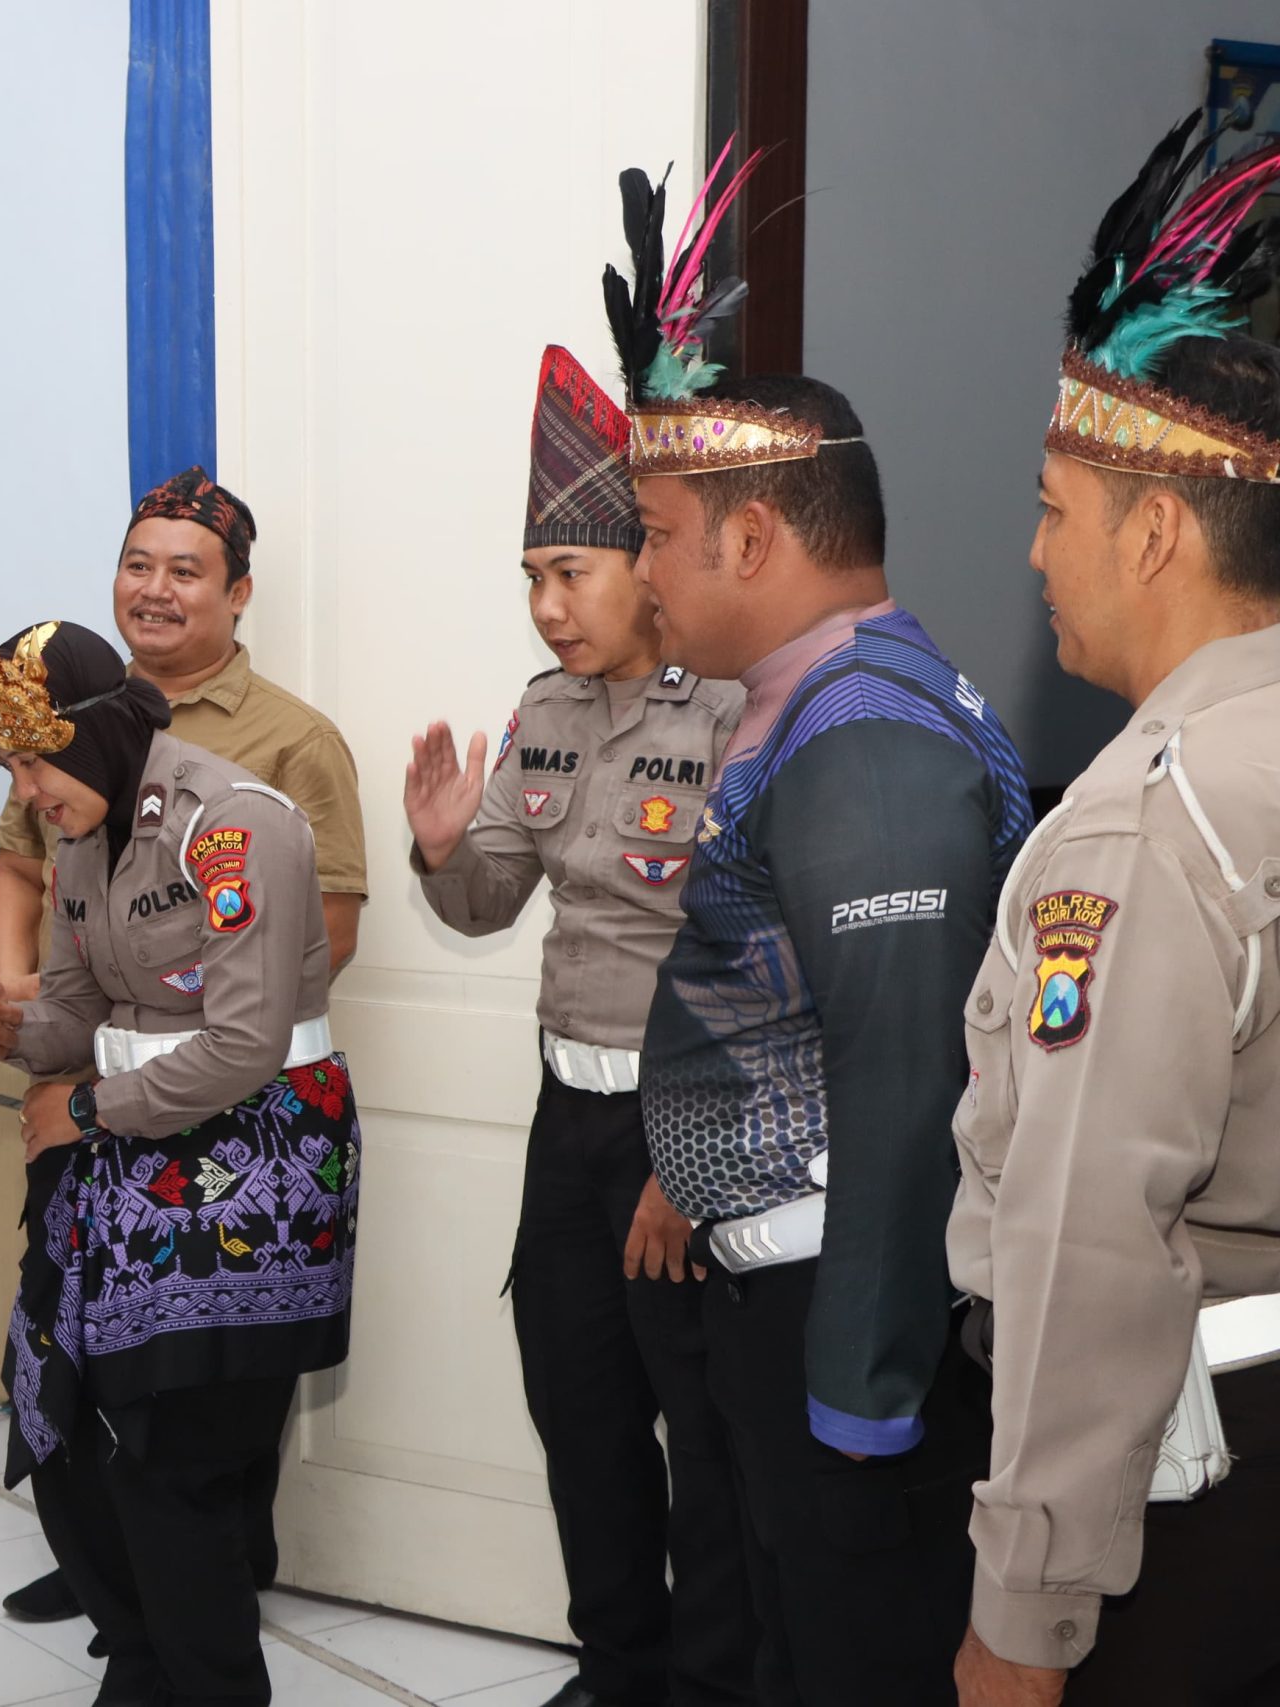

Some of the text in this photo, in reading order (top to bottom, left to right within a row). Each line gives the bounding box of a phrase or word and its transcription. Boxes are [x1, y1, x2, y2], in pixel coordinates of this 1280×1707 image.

[629, 756, 705, 785] POLRI
[191, 831, 243, 860] POLRES
[220, 841, 243, 851] KOTA
[203, 861, 240, 879] JAWA TIMUR
[127, 880, 199, 922] POLRI
[832, 889, 948, 927] PRESISI
[1036, 894, 1107, 917] POLRES
[1037, 908, 1102, 929] KEDIRI KOTA
[1040, 932, 1095, 950] JAWA TIMUR
